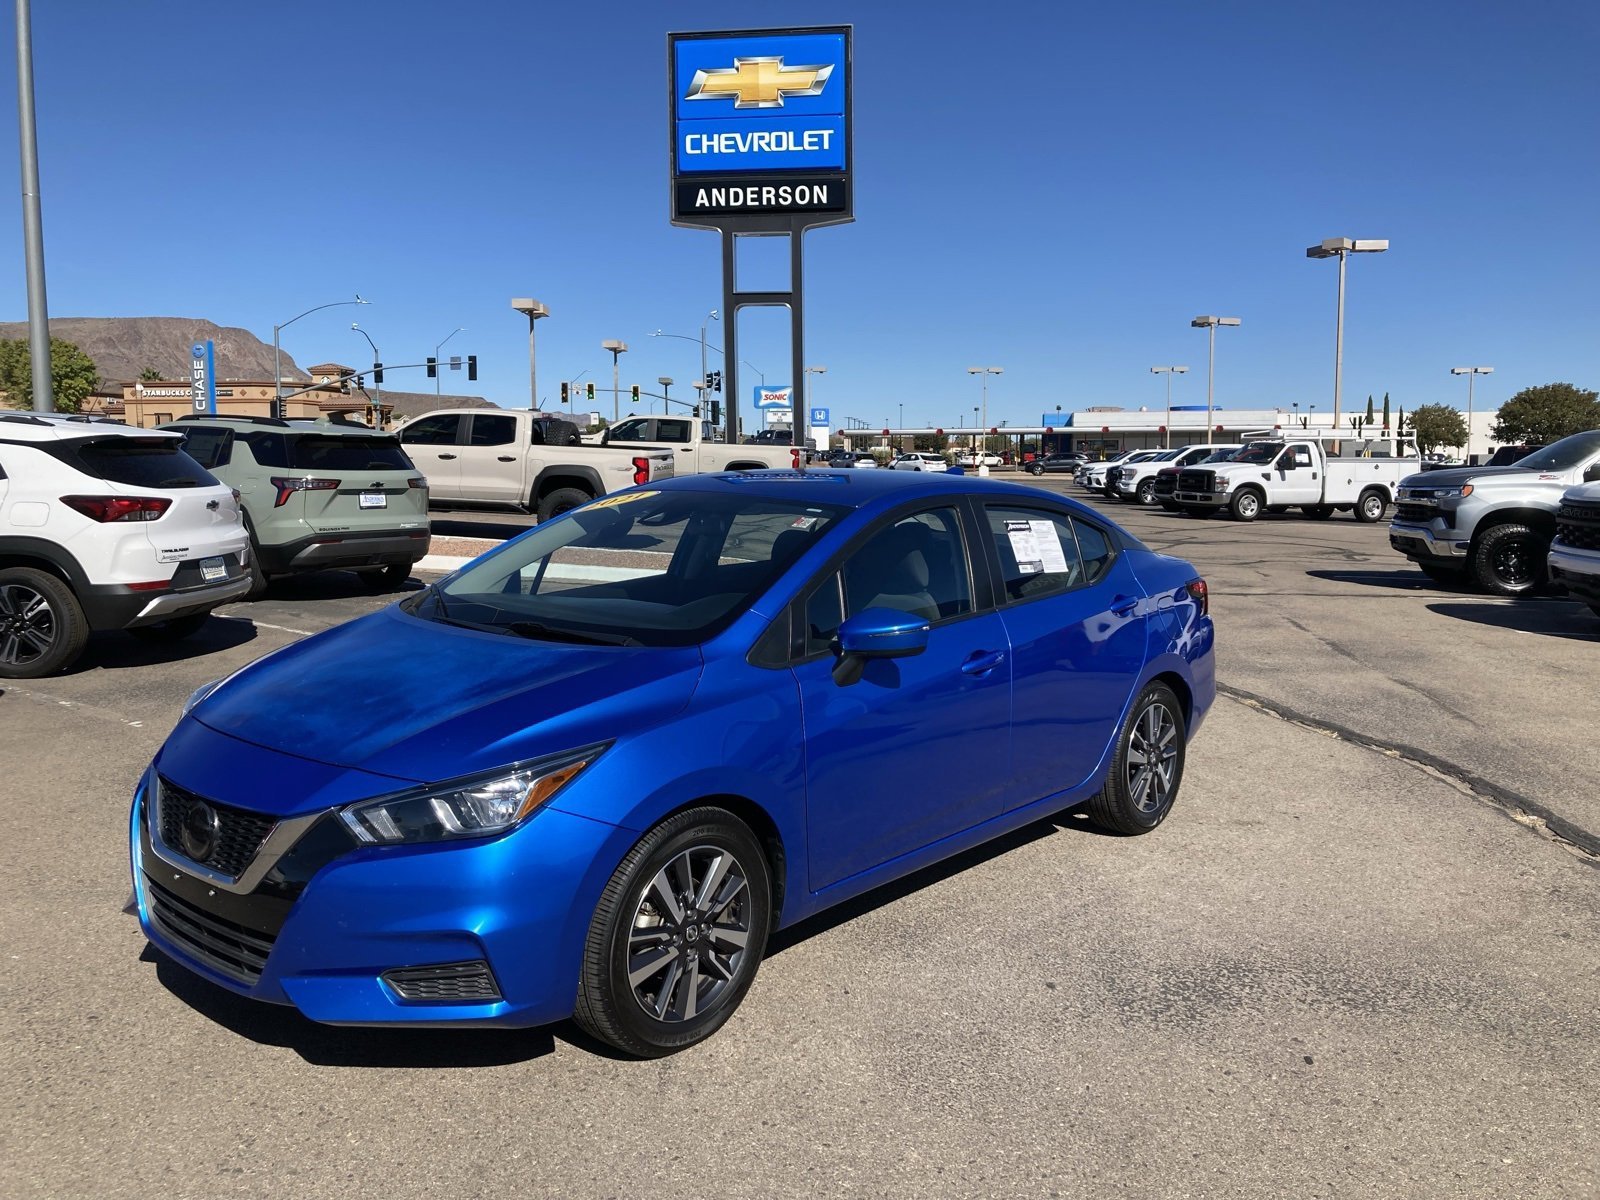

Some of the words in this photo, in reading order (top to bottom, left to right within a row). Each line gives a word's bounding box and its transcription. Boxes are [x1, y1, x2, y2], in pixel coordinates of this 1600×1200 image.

[685, 129, 834, 155] CHEVROLET
[695, 184, 828, 208] ANDERSON
[142, 389, 185, 397] STARBUCKS
[193, 359, 206, 411] CHASE
[763, 393, 788, 401] SONIC
